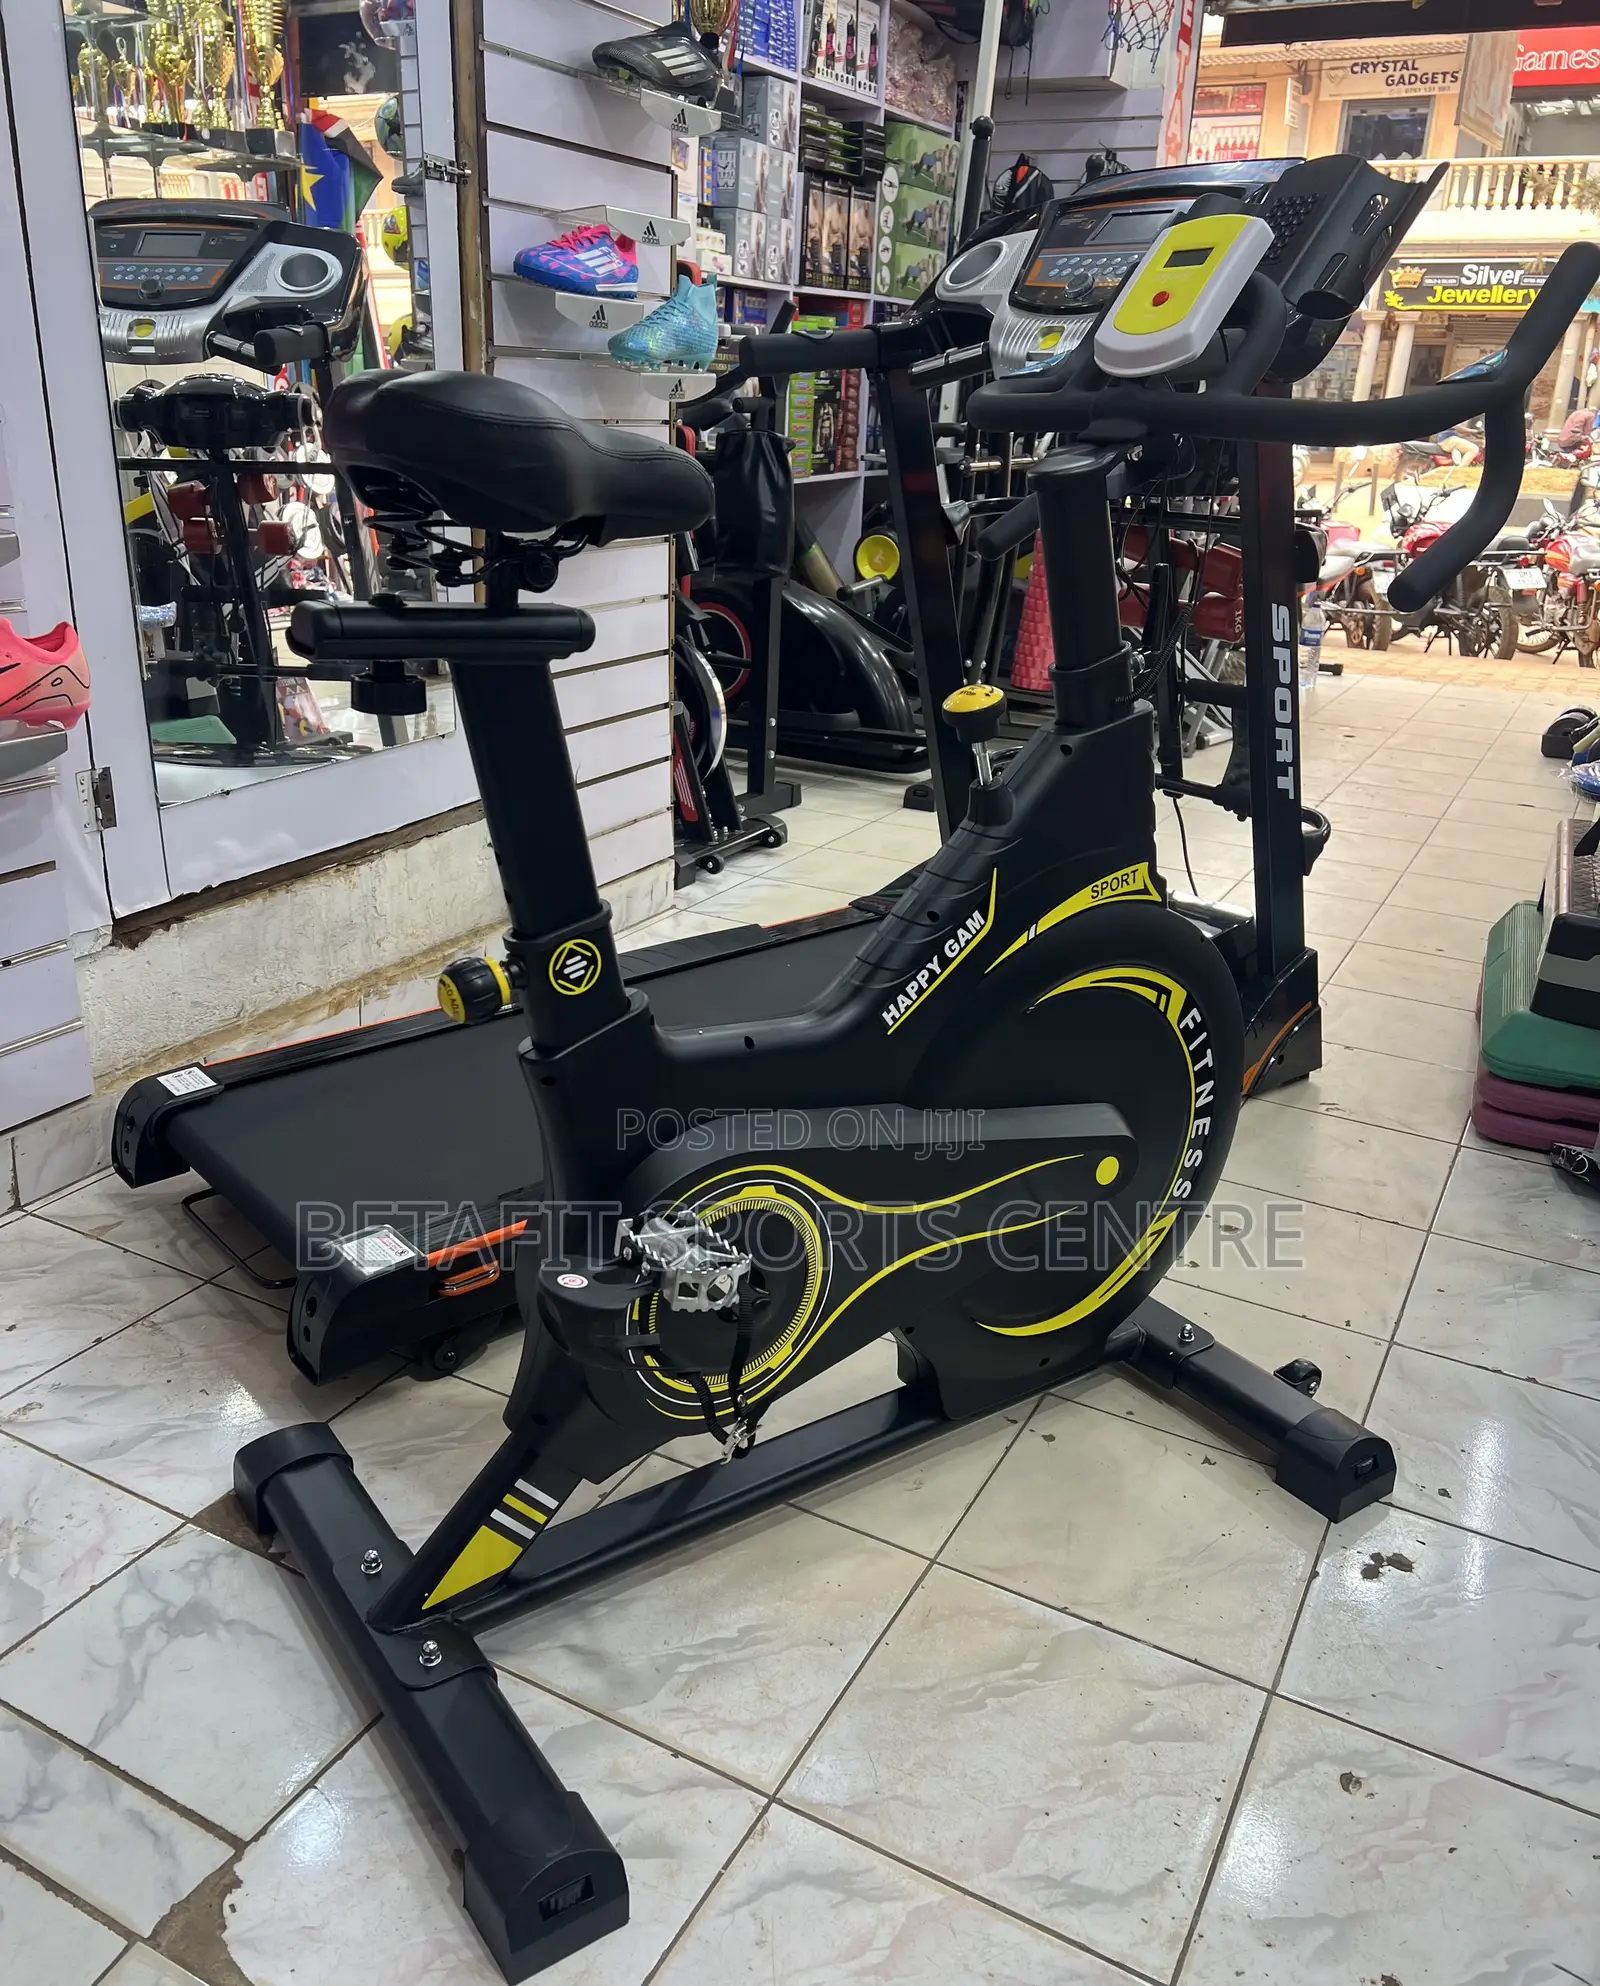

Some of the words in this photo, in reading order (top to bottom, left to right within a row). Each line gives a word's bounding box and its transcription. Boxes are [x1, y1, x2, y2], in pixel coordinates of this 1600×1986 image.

[1350, 59, 1419, 75] CRYSTAL
[1385, 71, 1459, 86] GADGETS
[670, 122, 689, 133] adidas
[641, 235, 660, 245] adidas
[1460, 264, 1525, 285] Silver
[589, 318, 609, 330] adidas
[669, 391, 686, 400] adidas
[1234, 610, 1242, 633] 1KG
[1271, 602, 1295, 800] SPORT
[1090, 868, 1139, 900] SPORT
[881, 955, 943, 1027] HAPPY
[944, 910, 986, 959] GAM
[1173, 1007, 1214, 1199] FITNESS
